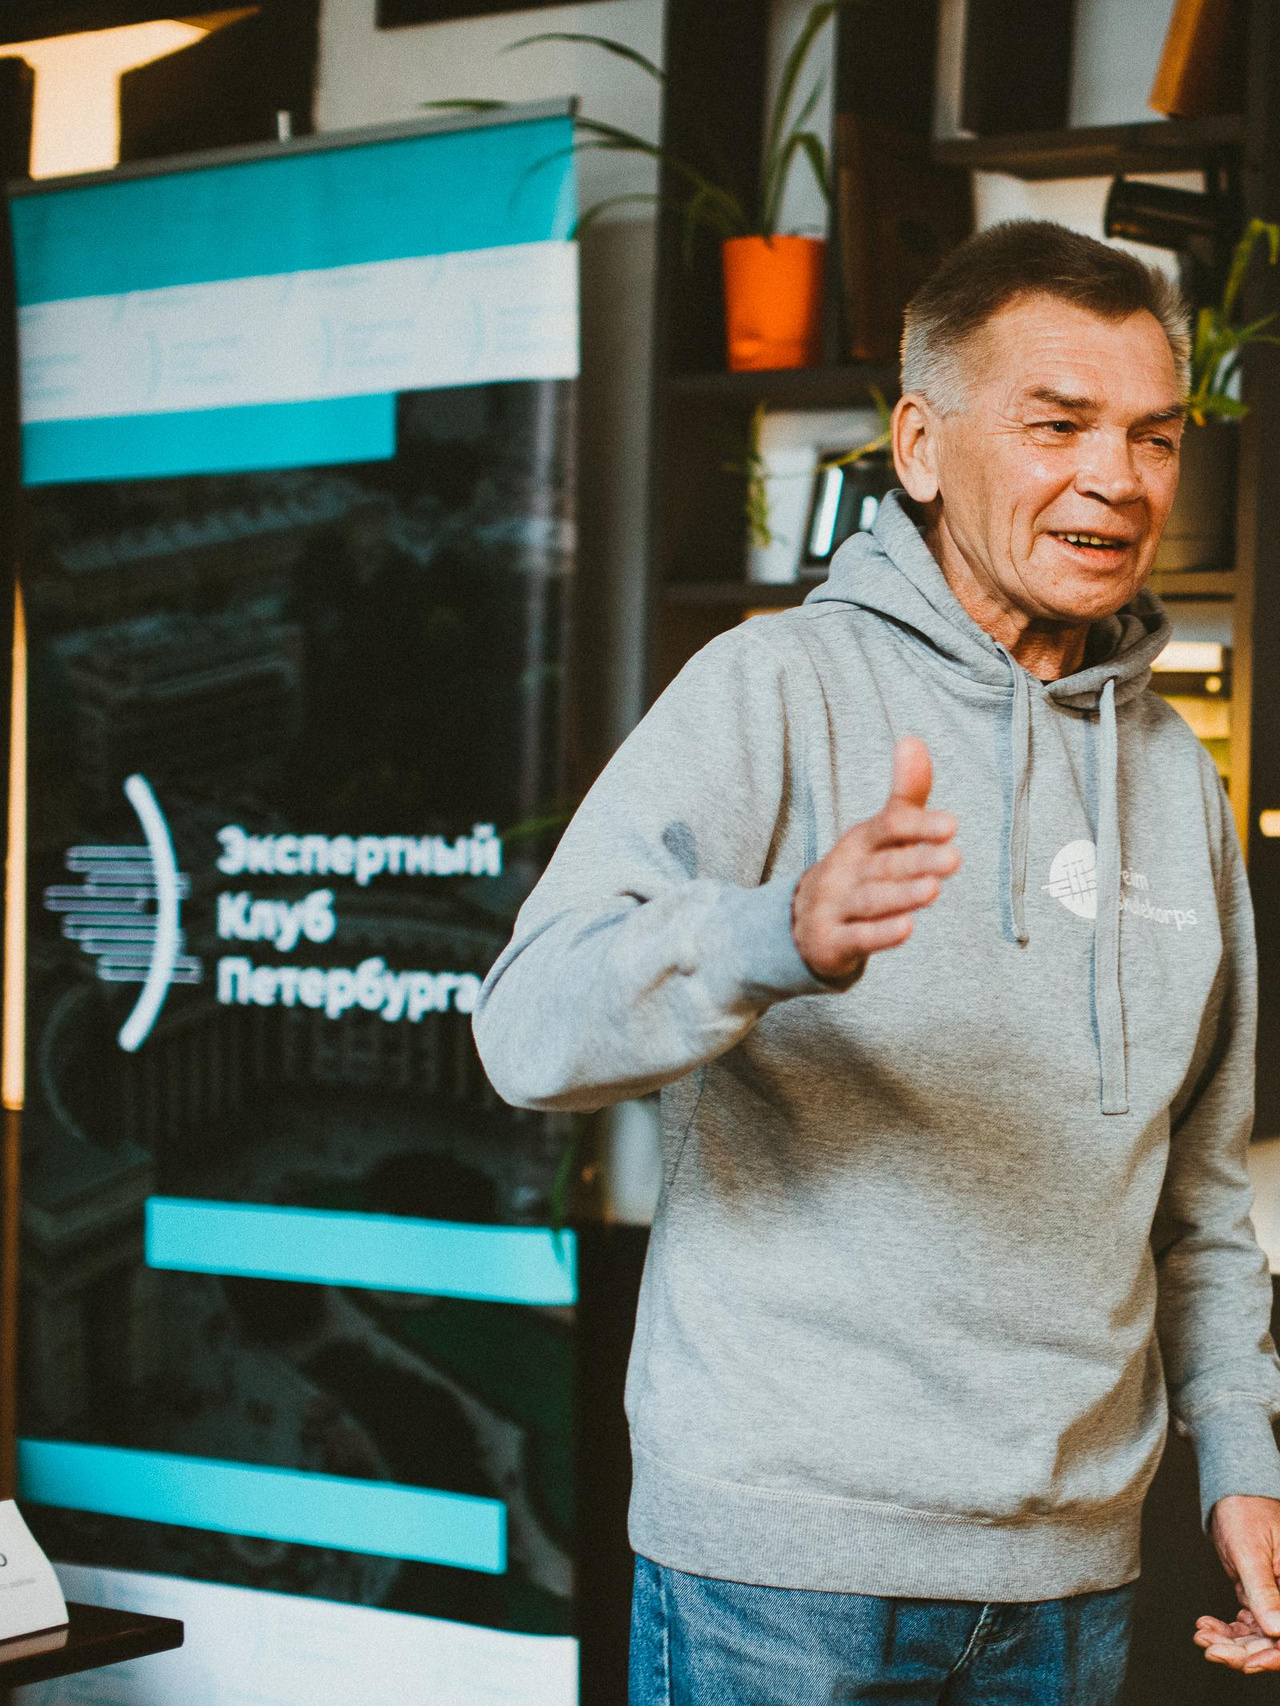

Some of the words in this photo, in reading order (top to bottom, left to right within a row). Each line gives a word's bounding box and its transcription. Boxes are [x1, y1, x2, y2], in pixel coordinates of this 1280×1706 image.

[216, 822, 502, 887] Экспертный
[216, 888, 338, 953] Клуб
[216, 955, 483, 1022] Петербурга
